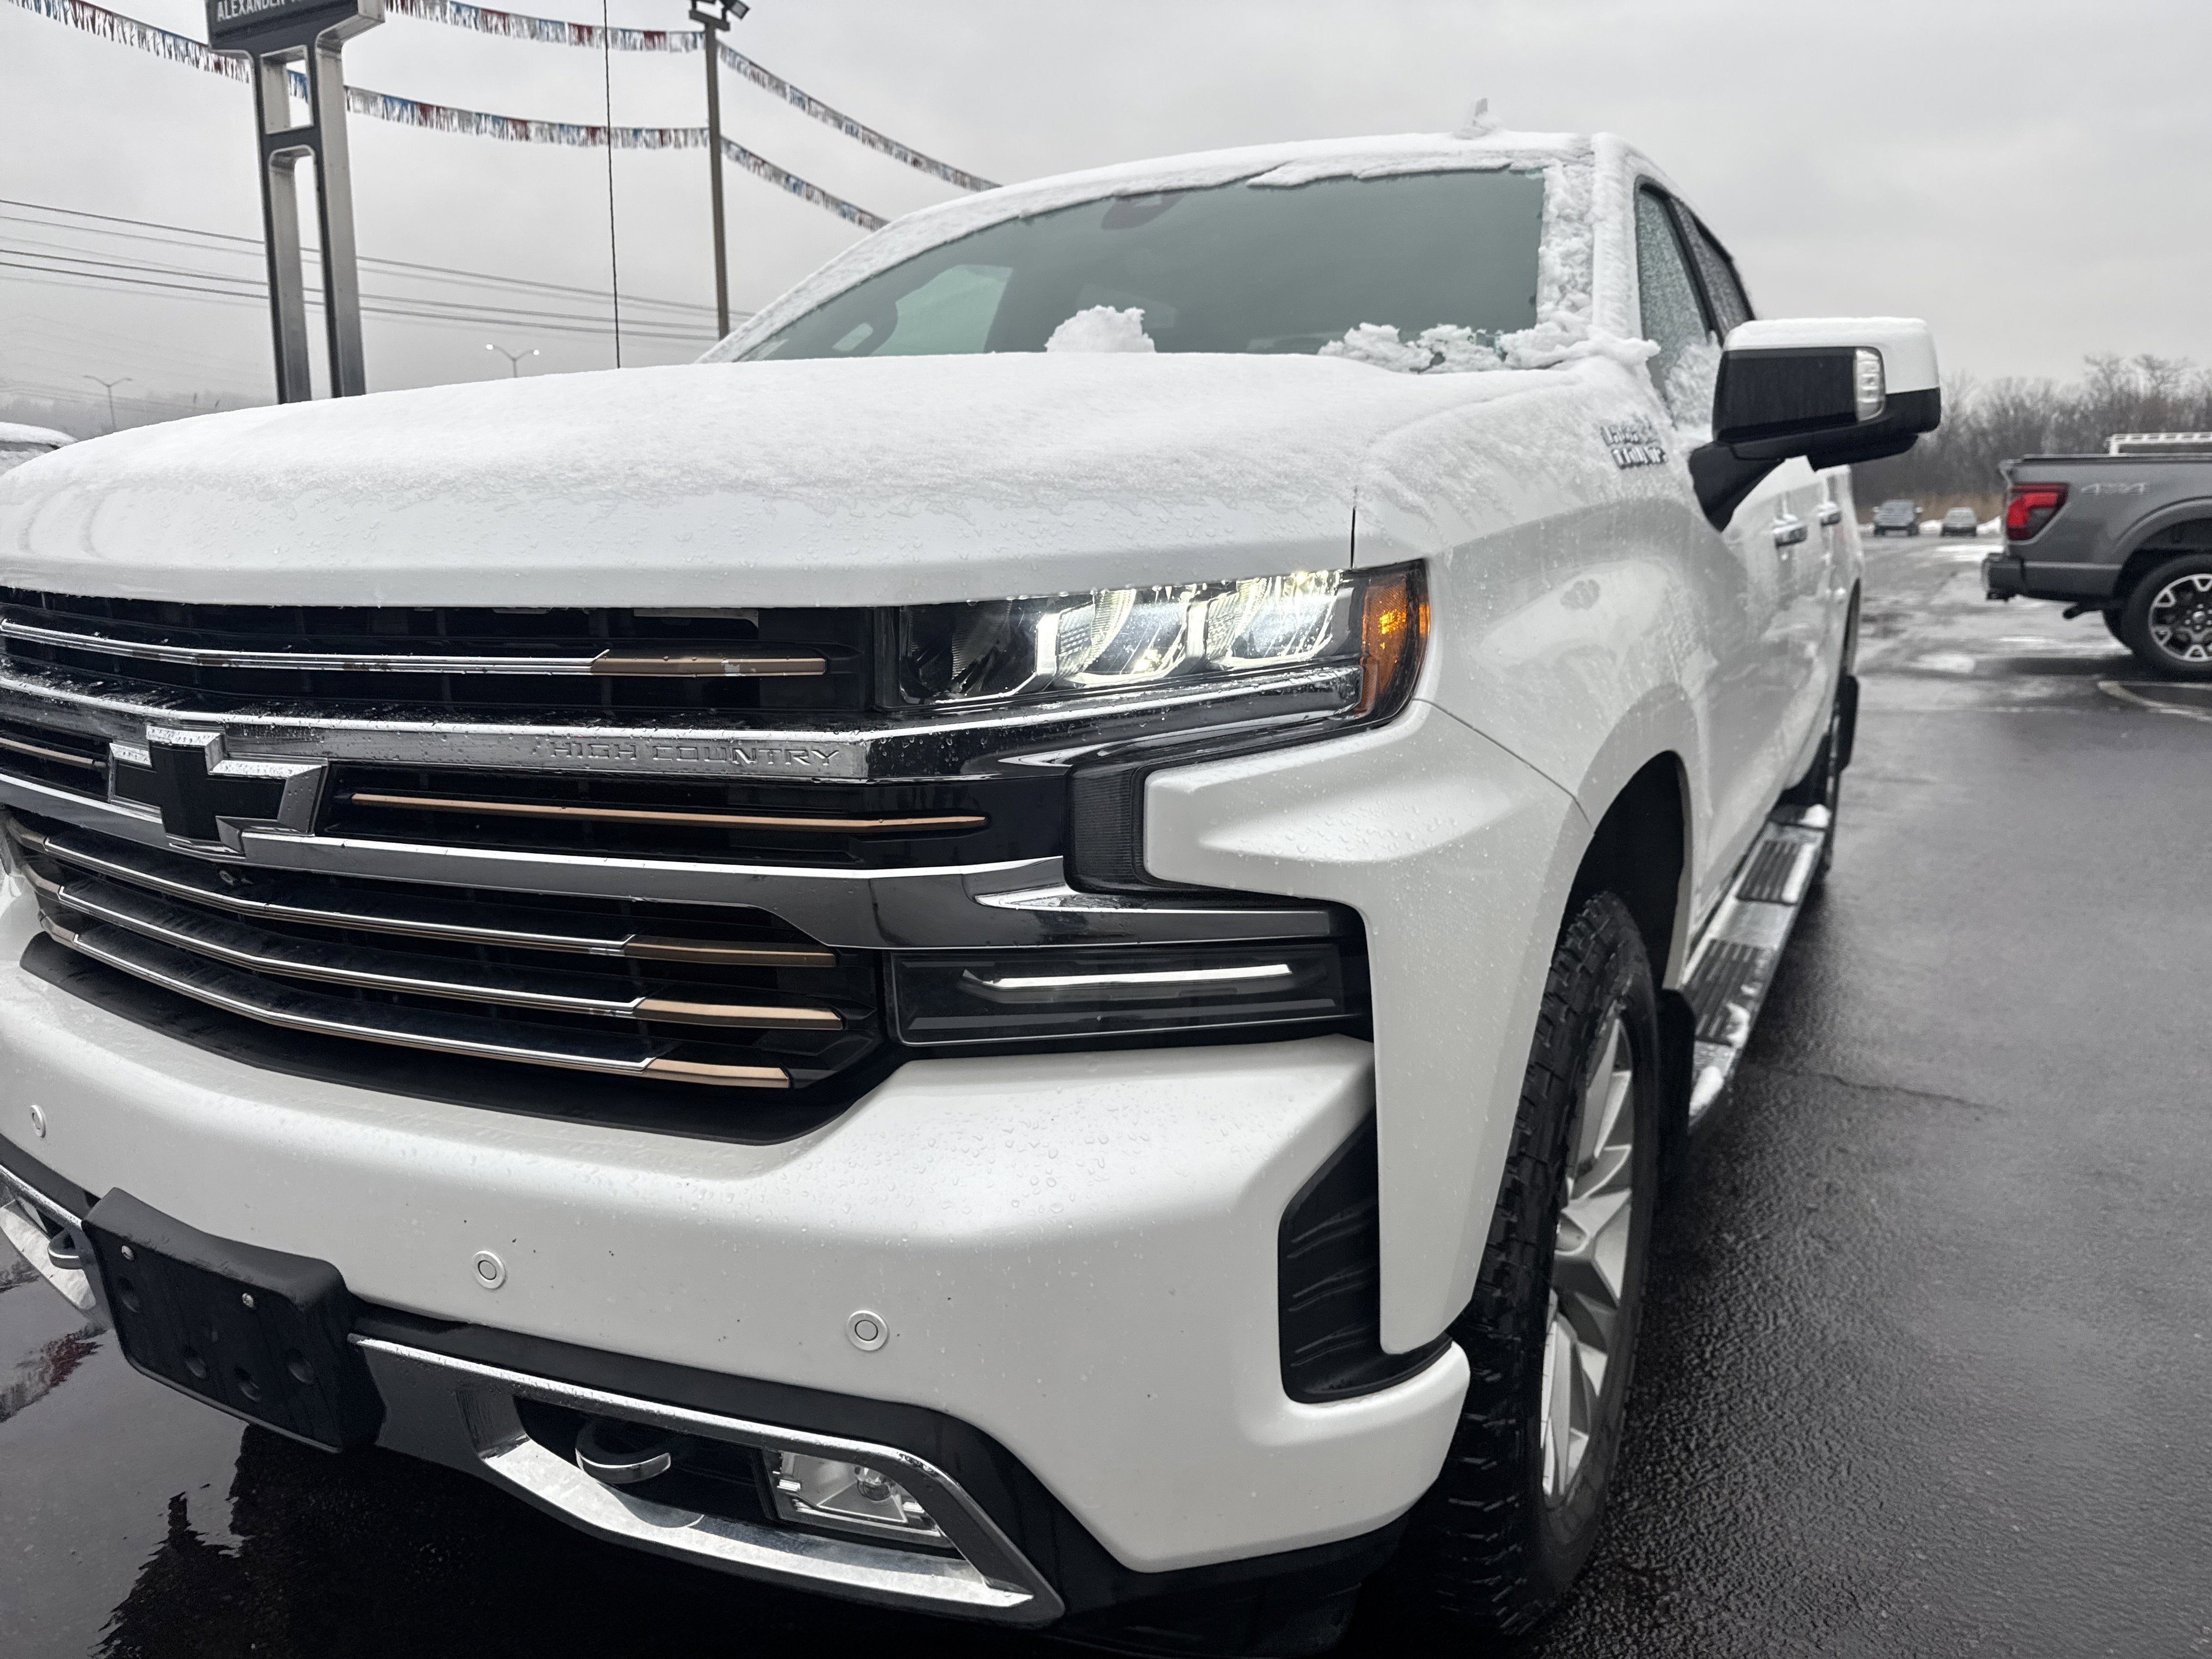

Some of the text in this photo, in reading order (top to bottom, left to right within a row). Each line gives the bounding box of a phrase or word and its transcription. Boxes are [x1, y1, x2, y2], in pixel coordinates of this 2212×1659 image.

[217, 0, 285, 22] ALEXAN
[550, 742, 839, 766] HIGH COUNTRY
